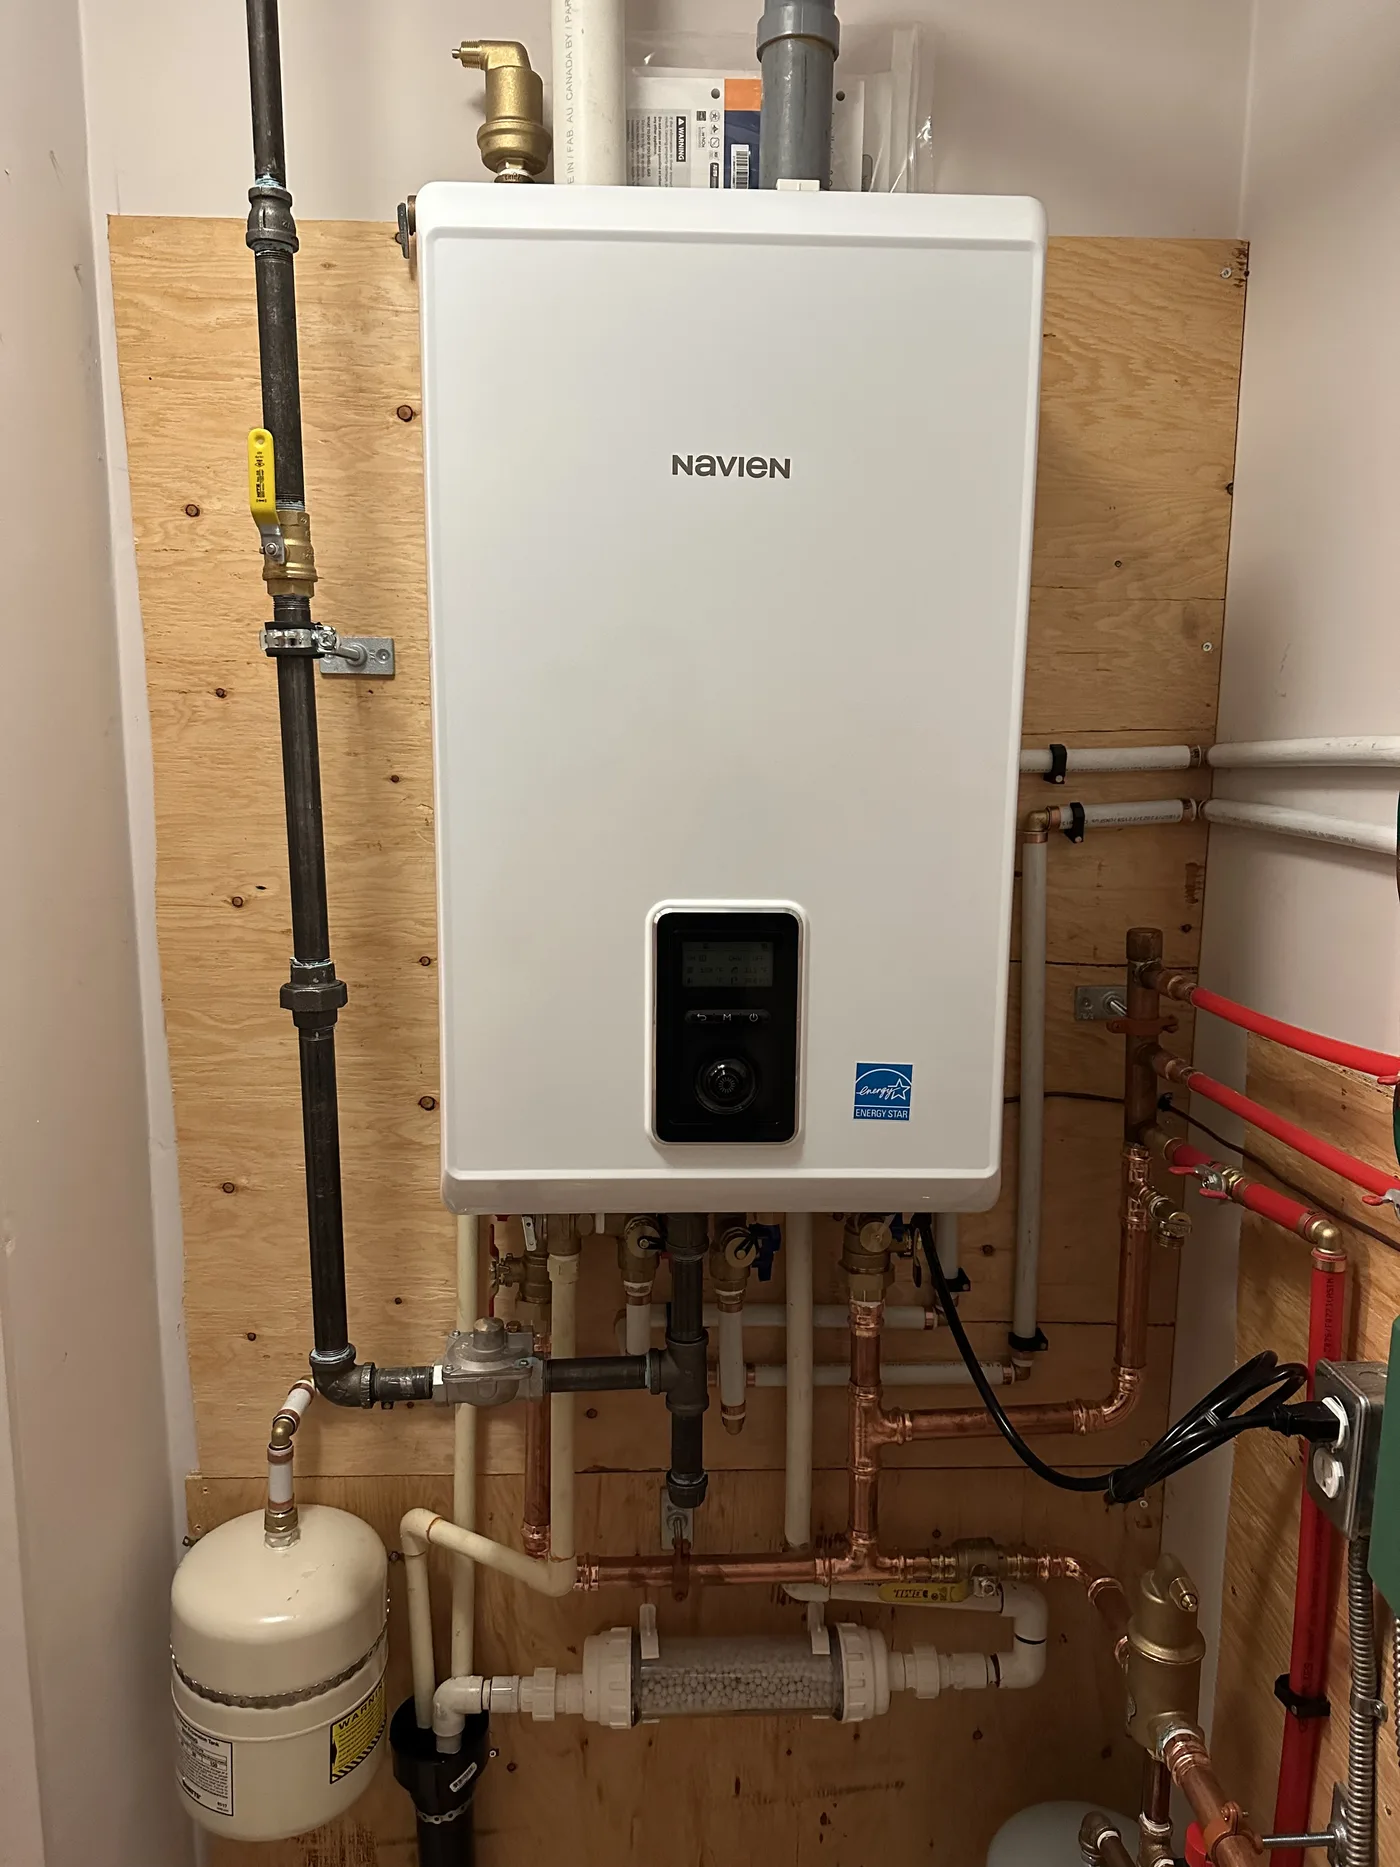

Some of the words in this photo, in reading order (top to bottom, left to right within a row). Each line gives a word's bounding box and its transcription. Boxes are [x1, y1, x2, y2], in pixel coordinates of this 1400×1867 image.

[565, 34, 572, 49] BY
[566, 162, 574, 174] IN
[856, 1086, 894, 1100] energy
[856, 1109, 886, 1118] ENERGY
[888, 1110, 908, 1118] STAR
[339, 1681, 382, 1730] WARNIN
